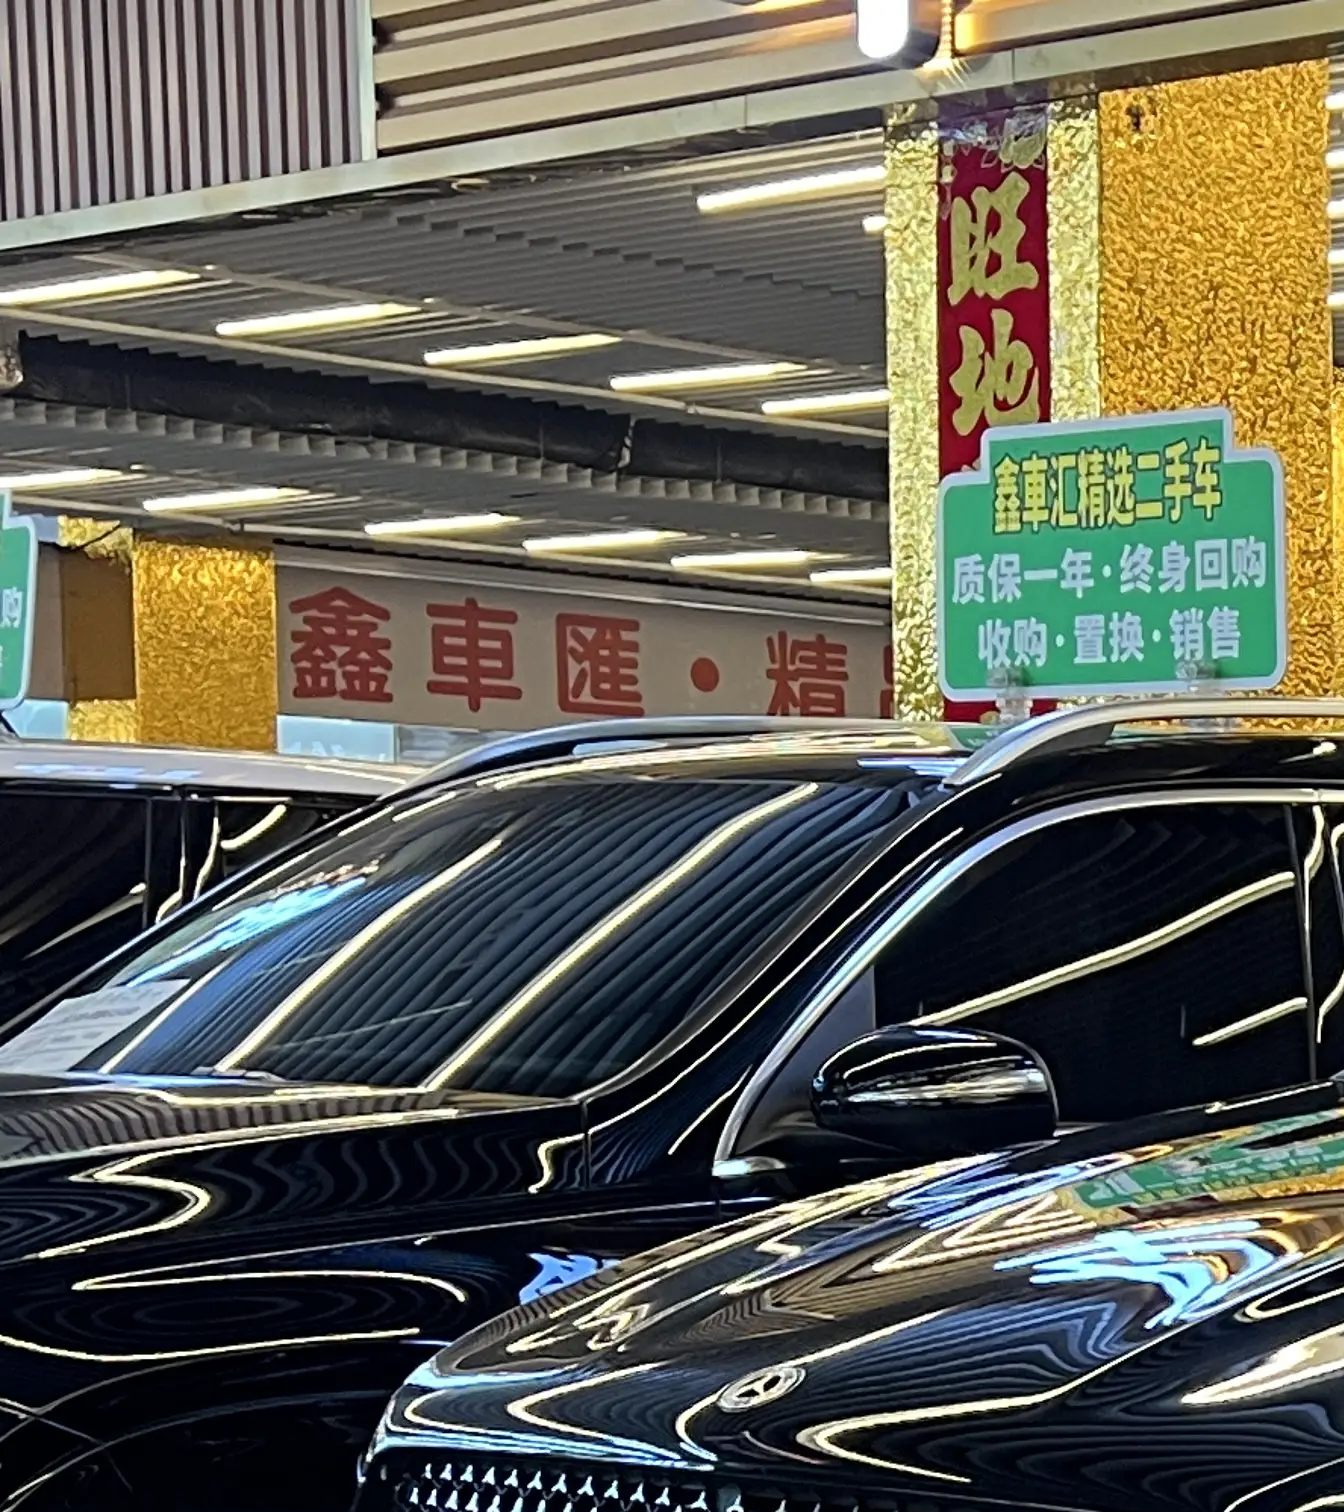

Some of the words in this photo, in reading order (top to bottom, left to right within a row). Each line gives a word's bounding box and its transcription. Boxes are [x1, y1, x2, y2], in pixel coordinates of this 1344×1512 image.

[993, 436, 1224, 535] 鑫車汇精选二手车
[951, 535, 1268, 605] 质保一年·终身回购
[288, 586, 893, 719] 鑫車匯·精
[978, 605, 1241, 670] 收购·置换·销售
